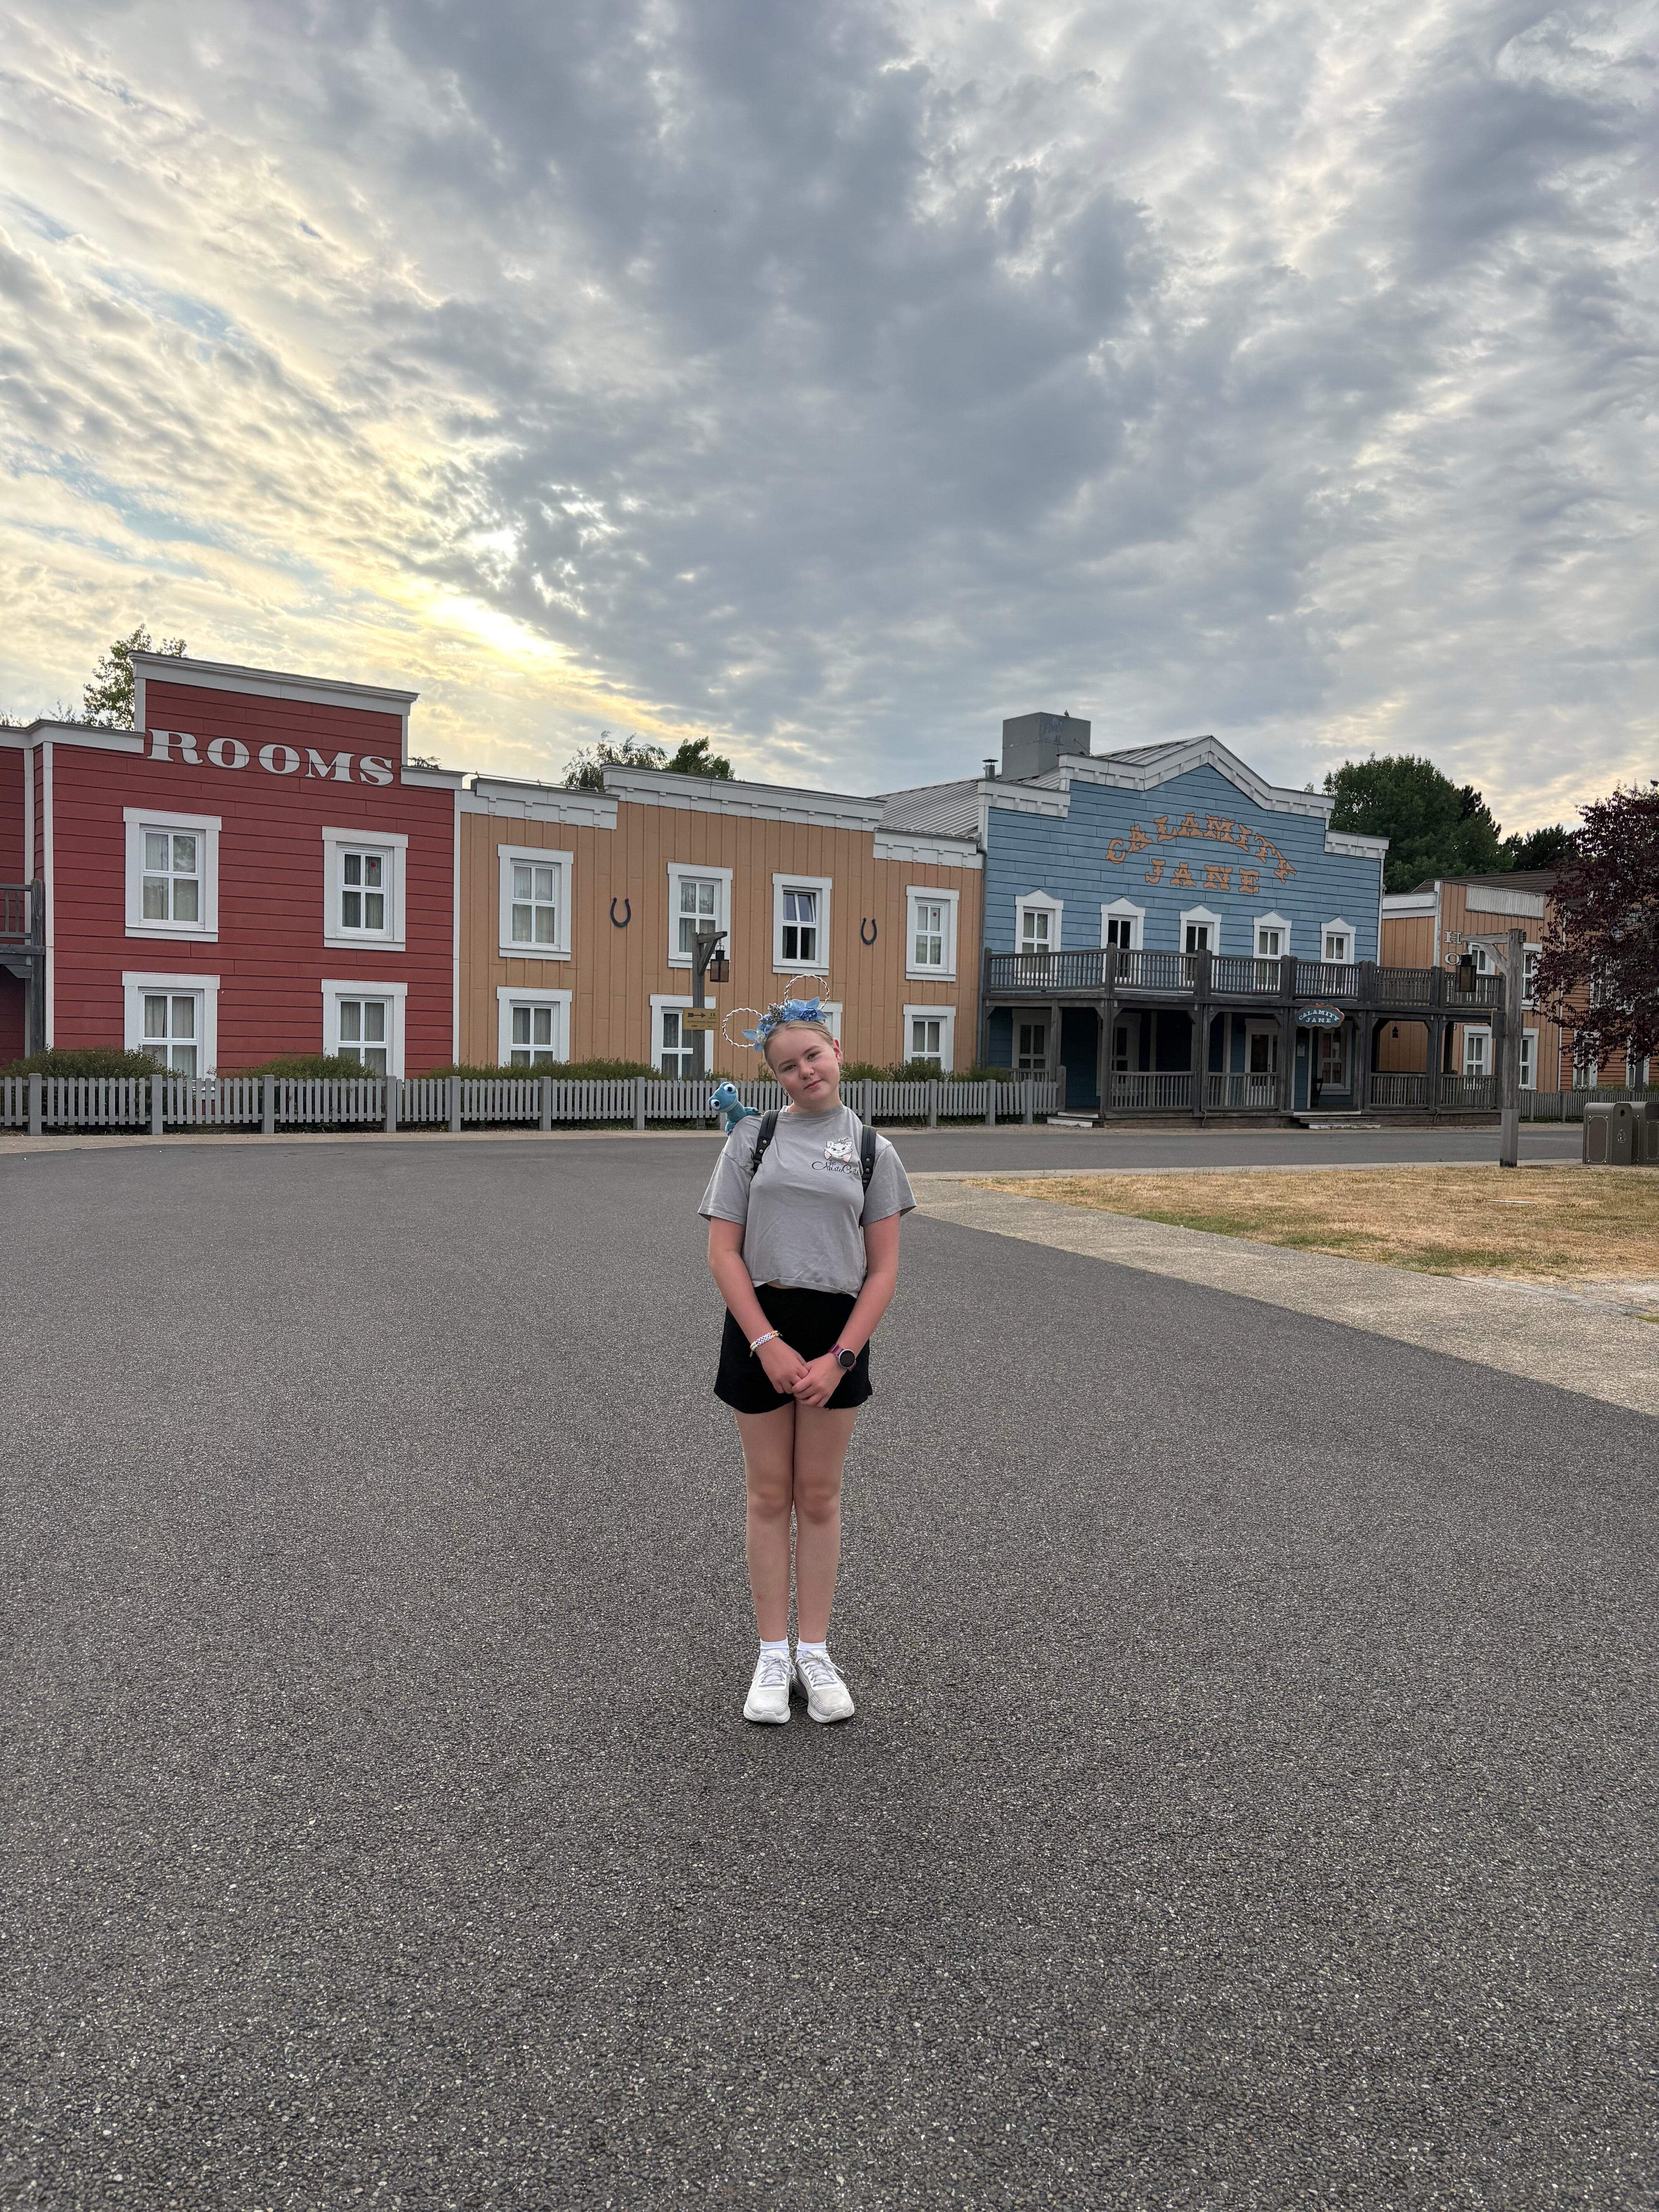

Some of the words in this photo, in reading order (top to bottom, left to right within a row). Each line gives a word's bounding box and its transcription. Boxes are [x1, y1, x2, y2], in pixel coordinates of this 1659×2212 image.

[146, 728, 394, 786] ROOMS
[1105, 812, 1297, 884] CALAMITY
[1145, 859, 1260, 894] JANE
[1298, 1009, 1340, 1022] CALAMITY
